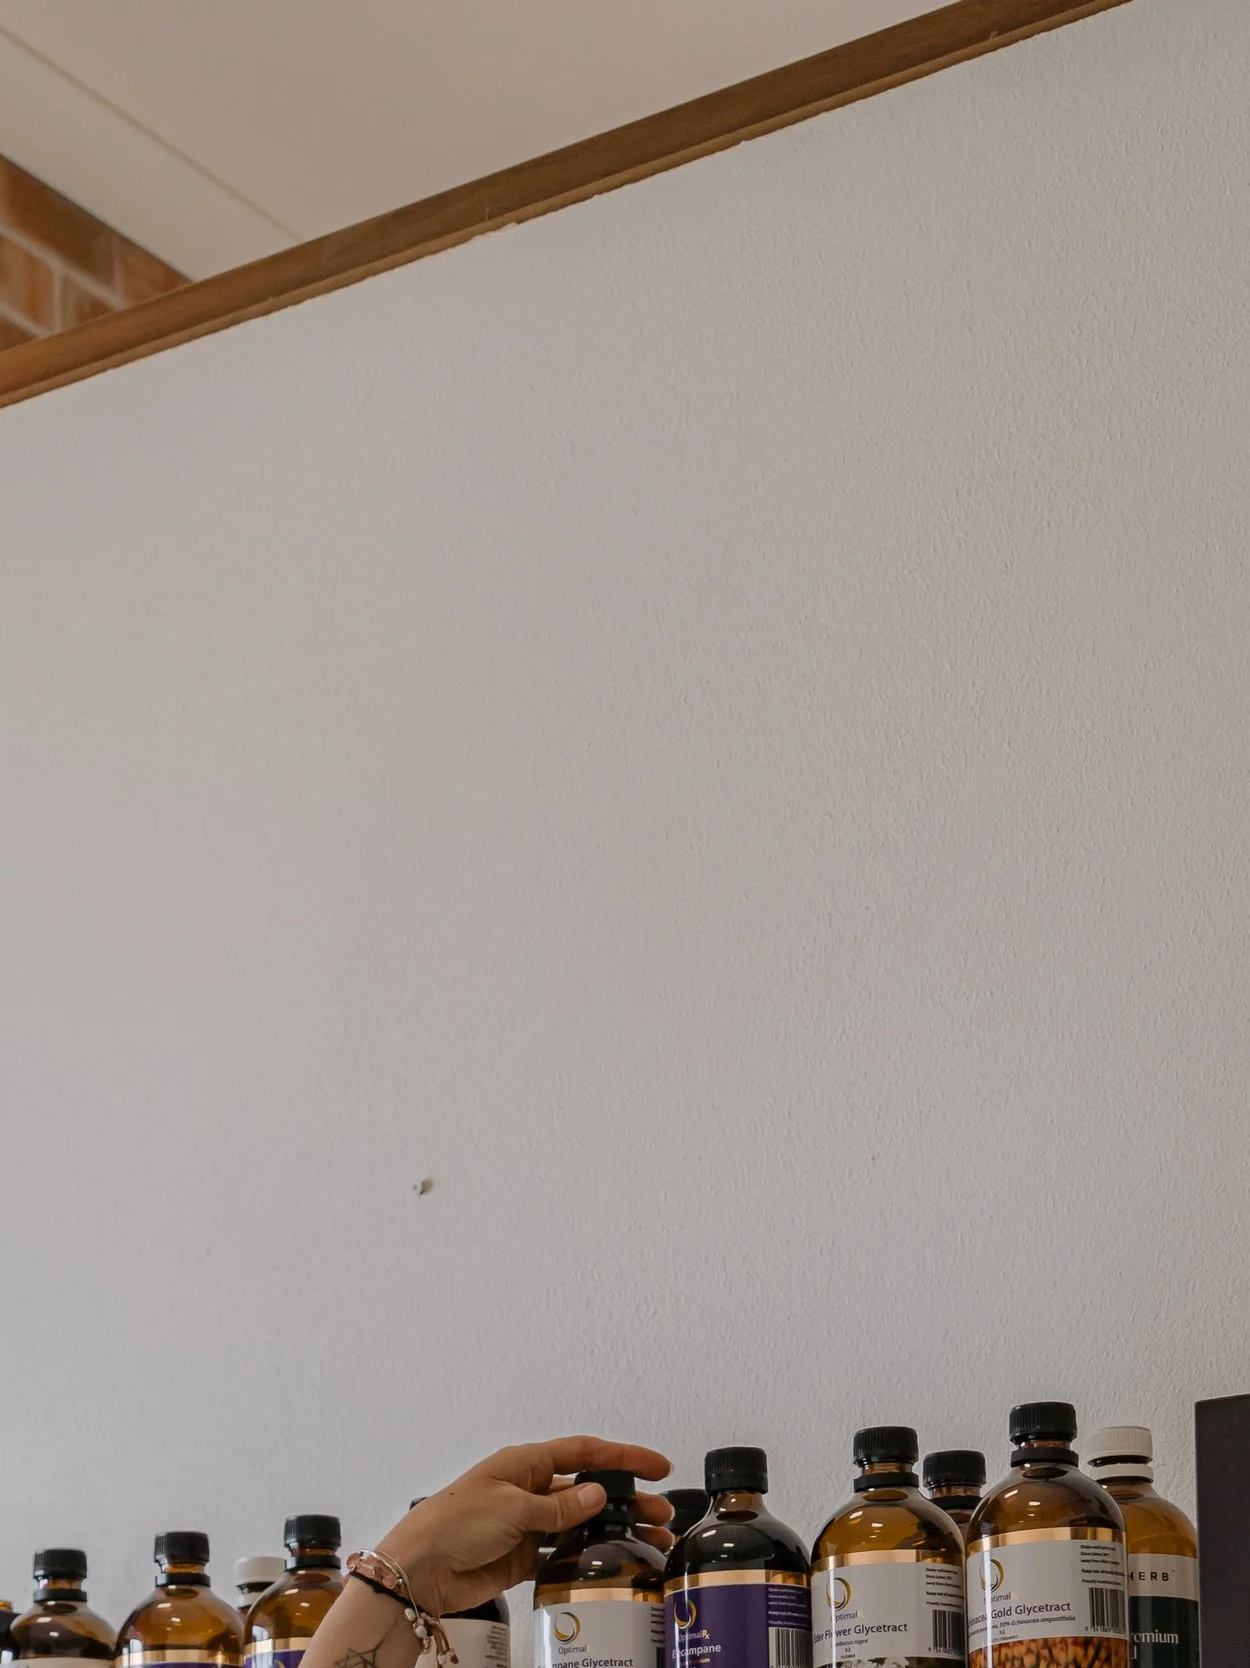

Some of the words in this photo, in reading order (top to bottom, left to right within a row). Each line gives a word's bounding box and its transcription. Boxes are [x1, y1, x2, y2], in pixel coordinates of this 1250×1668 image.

[1129, 1571, 1169, 1581] HERB
[984, 1592, 1010, 1604] timal
[991, 1606, 1012, 1618] Gold
[1015, 1602, 1071, 1616] Glycetract
[824, 1627, 851, 1639] Flwer
[854, 1623, 908, 1635] Glycetract
[558, 1644, 587, 1655] Optimal
[582, 1658, 633, 1668] Glycetract
